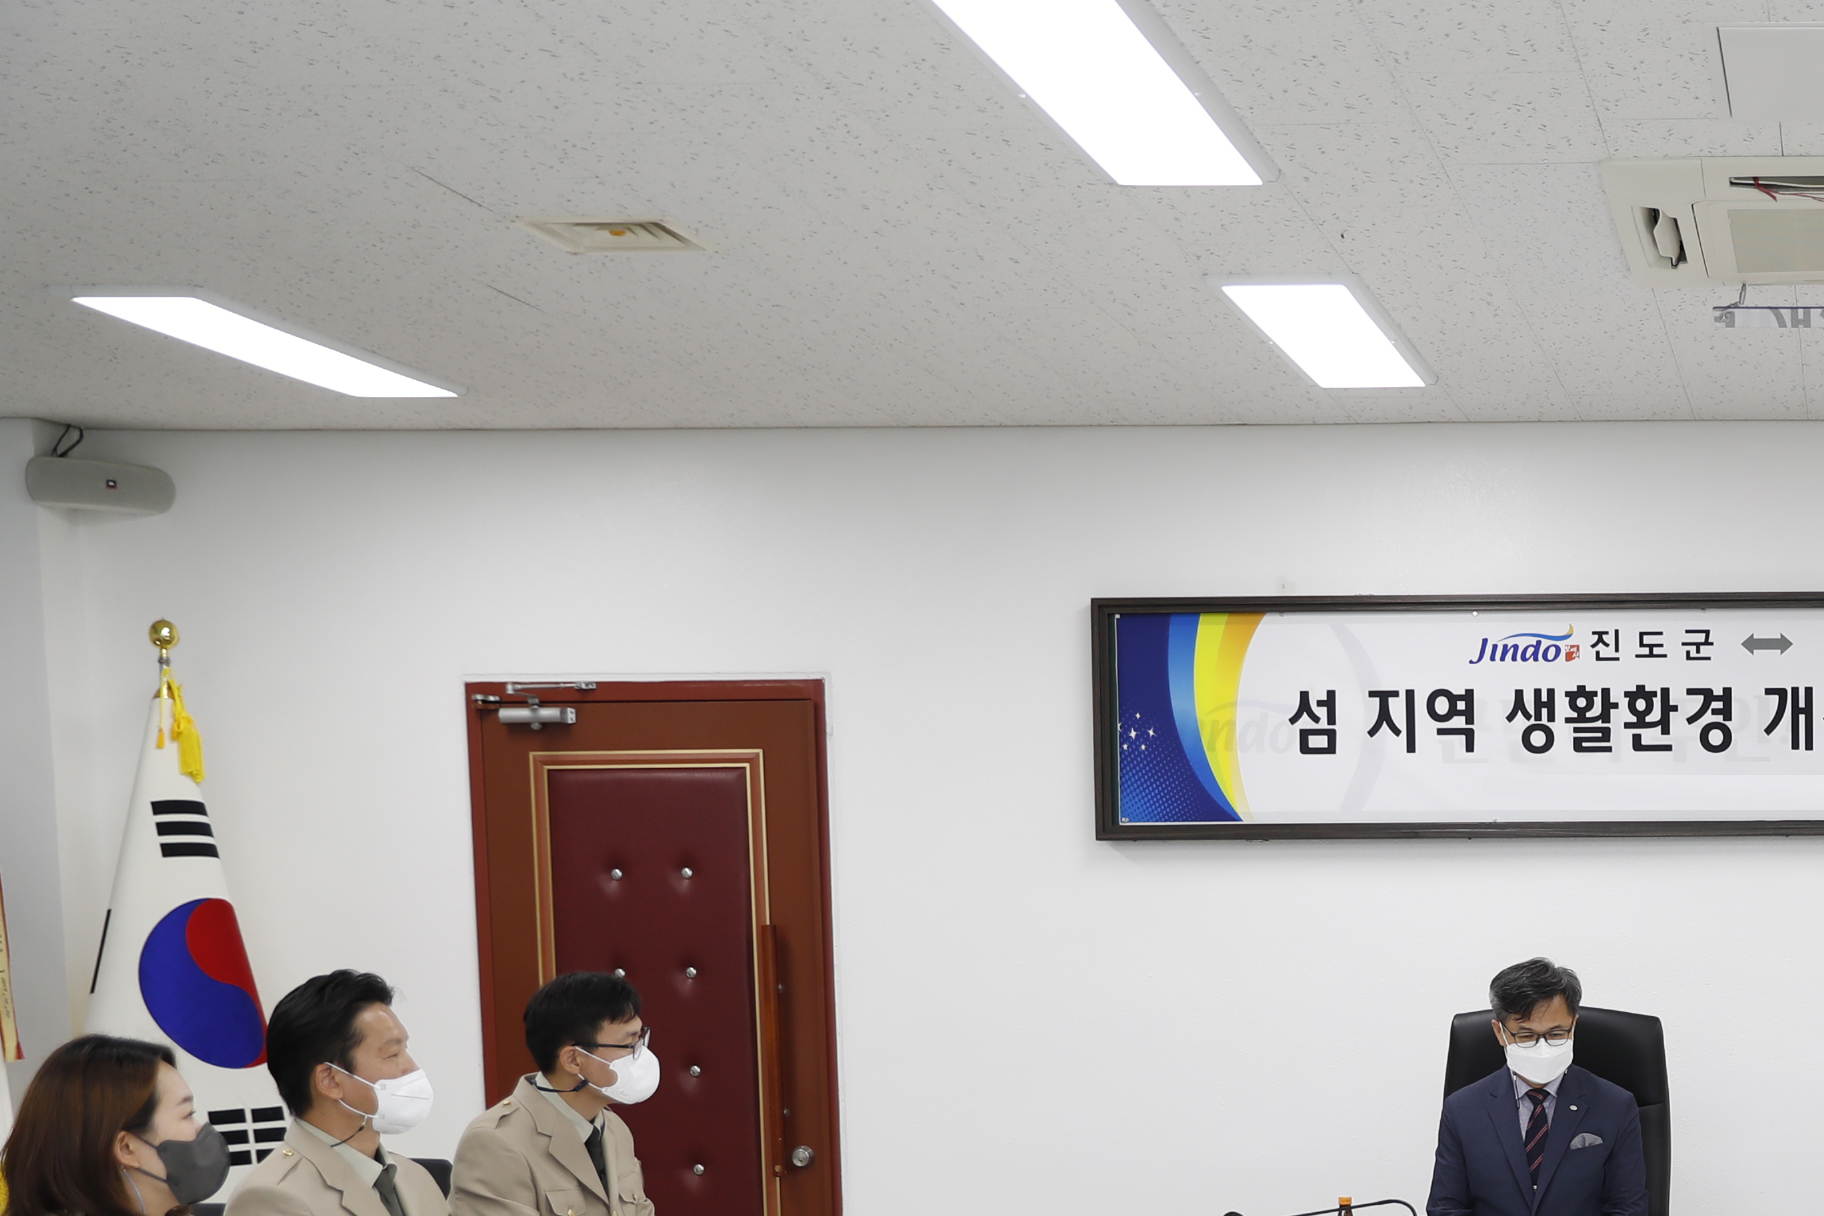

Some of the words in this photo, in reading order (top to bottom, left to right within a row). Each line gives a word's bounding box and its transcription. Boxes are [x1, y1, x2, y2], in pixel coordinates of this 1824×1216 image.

[1469, 637, 1563, 665] Jindo
[1288, 689, 1337, 755] 섬
[1366, 688, 1475, 754] 지역
[1505, 684, 1733, 755] 생활환경
